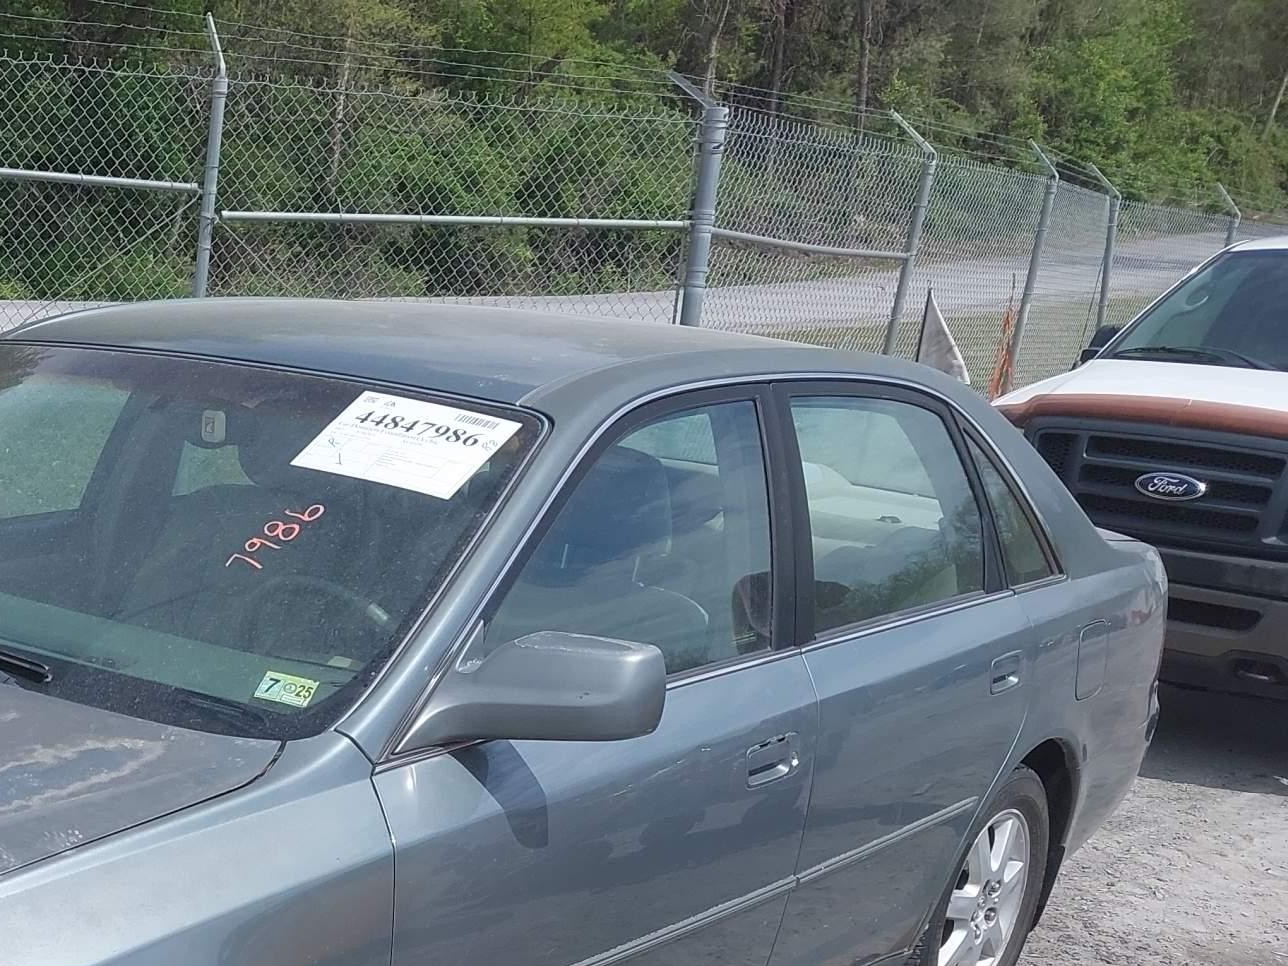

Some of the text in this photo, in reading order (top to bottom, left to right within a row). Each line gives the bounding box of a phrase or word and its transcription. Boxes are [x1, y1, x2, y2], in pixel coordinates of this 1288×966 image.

[355, 410, 487, 446] 44847986
[1147, 477, 1188, 494] Ford
[226, 504, 325, 569] 7986
[264, 677, 314, 699] 7 25
